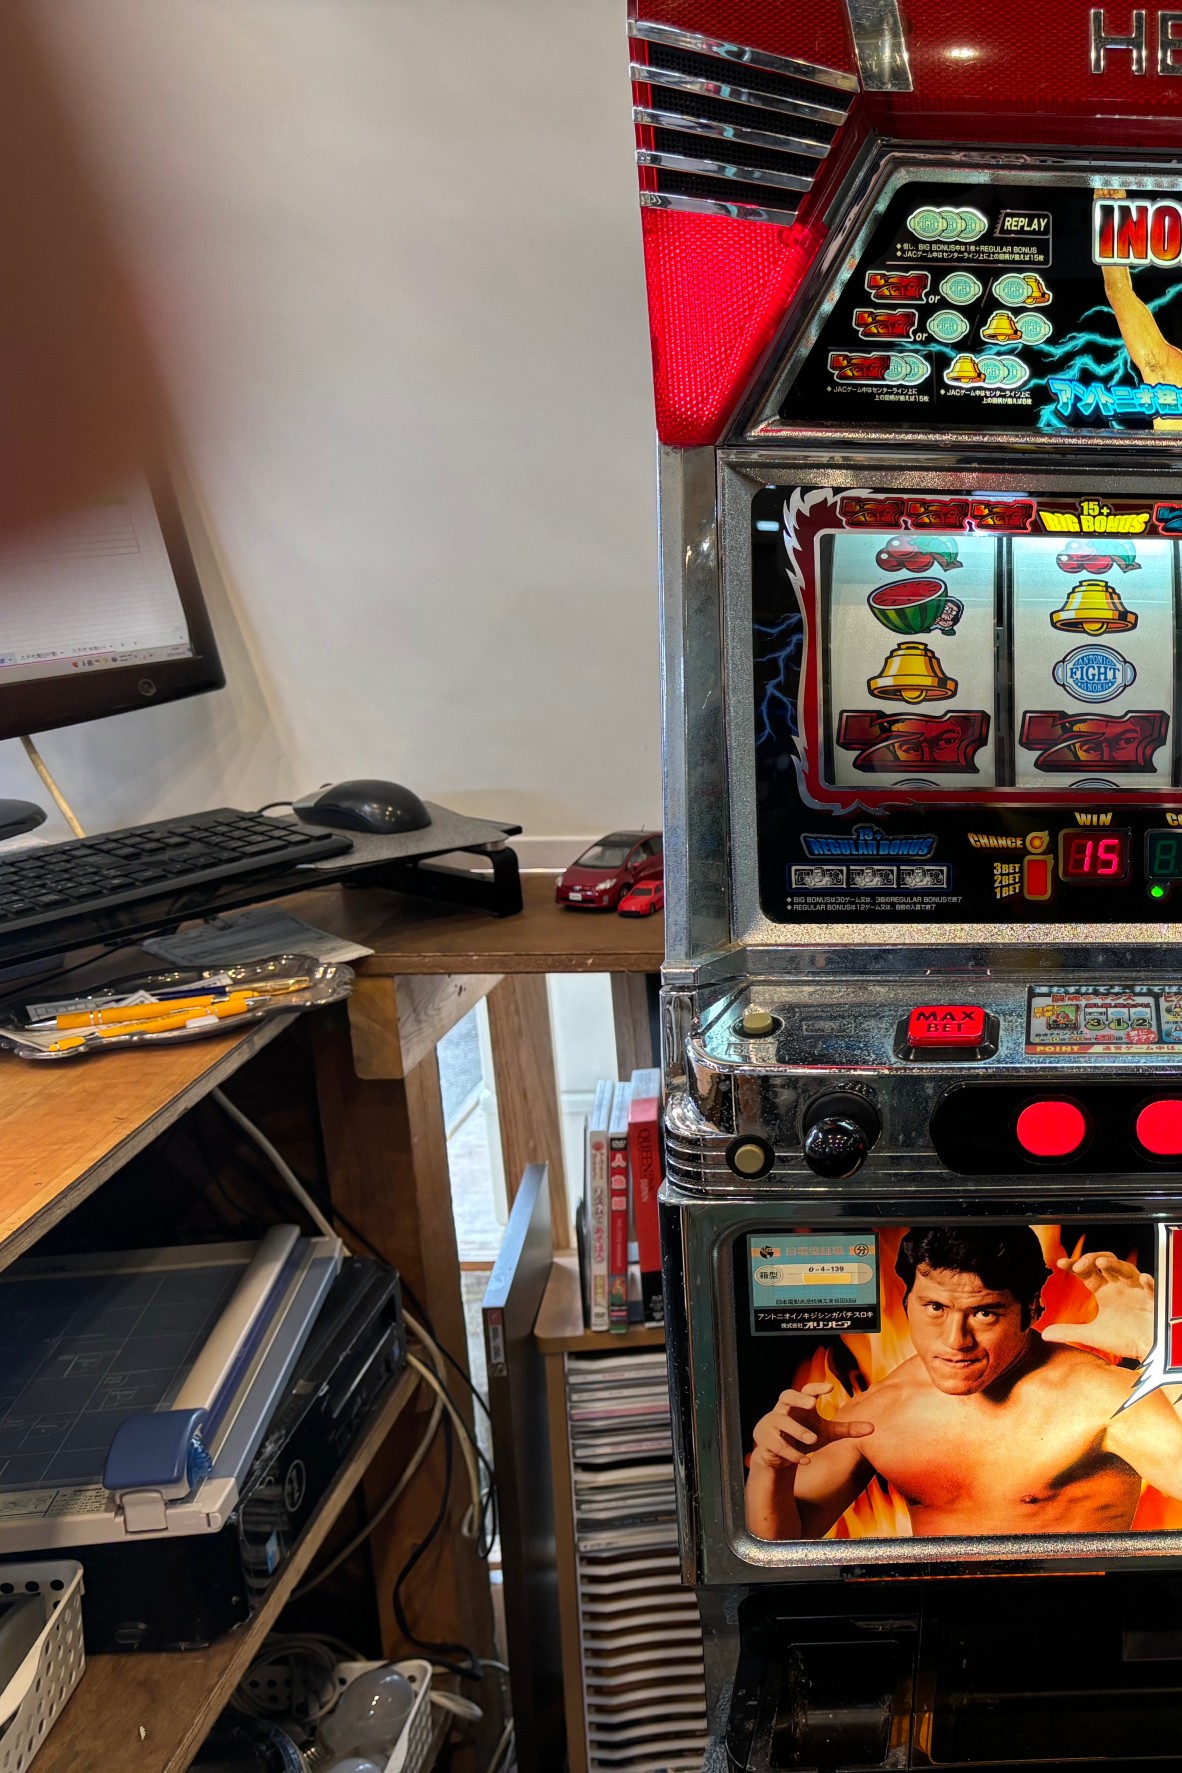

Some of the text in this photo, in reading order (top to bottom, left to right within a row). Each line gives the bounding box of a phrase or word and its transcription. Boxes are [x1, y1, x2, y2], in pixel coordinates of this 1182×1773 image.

[1003, 217, 1048, 231] REPLAY
[928, 295, 940, 304] or
[916, 333, 928, 341] or
[1040, 511, 1150, 533] BIG BONUS
[1077, 653, 1113, 665] ANTONIO
[1069, 665, 1120, 682] FIGHT
[1074, 812, 1113, 826] WIN
[807, 838, 935, 855] REGULAR BONUS
[967, 833, 1024, 848] CHANCE
[1084, 840, 1120, 874] 15
[916, 1011, 977, 1022] MAX
[926, 1023, 964, 1033] BET
